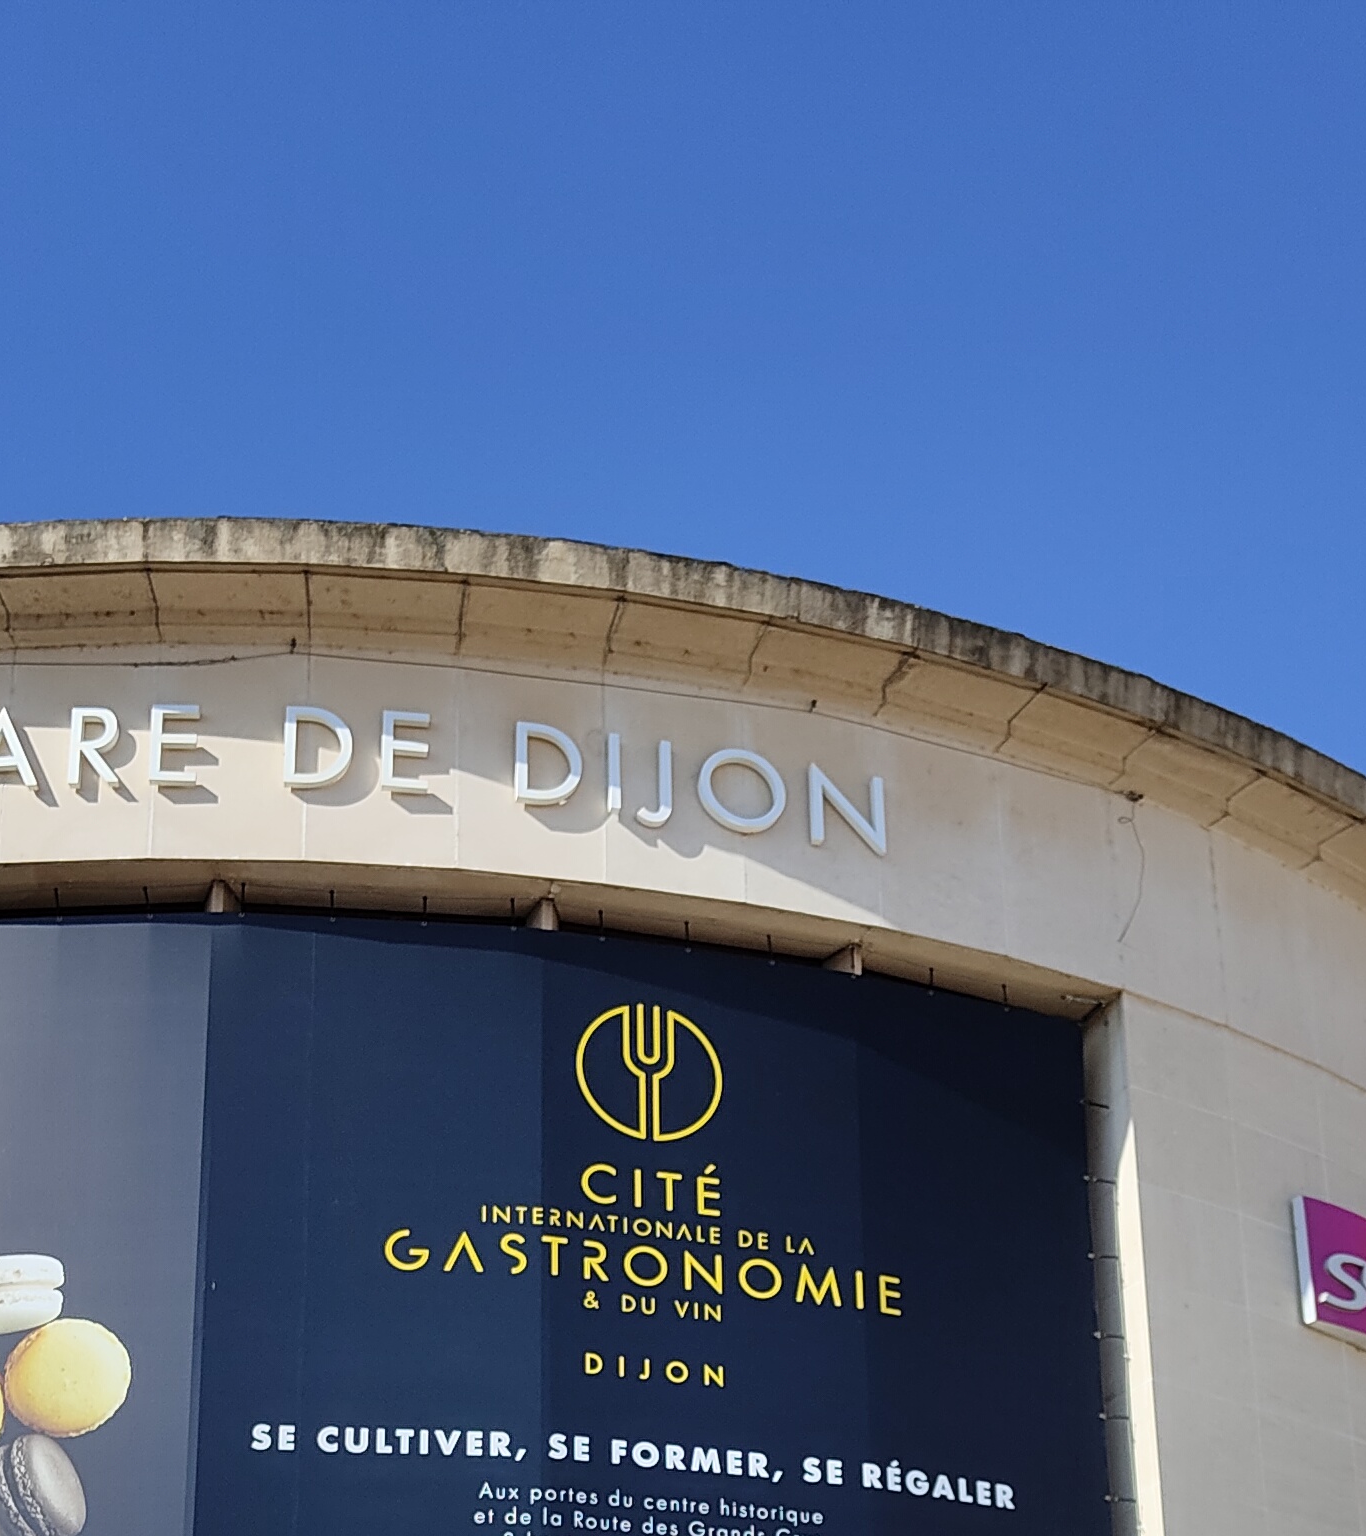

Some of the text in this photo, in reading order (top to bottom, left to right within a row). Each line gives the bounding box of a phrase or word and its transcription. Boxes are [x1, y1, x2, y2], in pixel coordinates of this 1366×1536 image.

[285, 705, 430, 794] DE
[515, 720, 888, 856] DIJON
[580, 1163, 721, 1217] CITÉ
[481, 1205, 815, 1256] INTERNATIONALE DE LA
[384, 1229, 902, 1317] GASTRONOMIE
[583, 1290, 722, 1323] & DU VIN
[584, 1351, 724, 1388] DIJON
[250, 1423, 1016, 1510] SE CULTIVER, SE FORMER, SE RÉGALER
[473, 1508, 495, 1525] et
[504, 1505, 532, 1525] de
[542, 1506, 562, 1527] la
[573, 1510, 632, 1533] Route
[641, 1515, 679, 1536] des
[478, 1481, 824, 1527] Aux portes du centre historique
